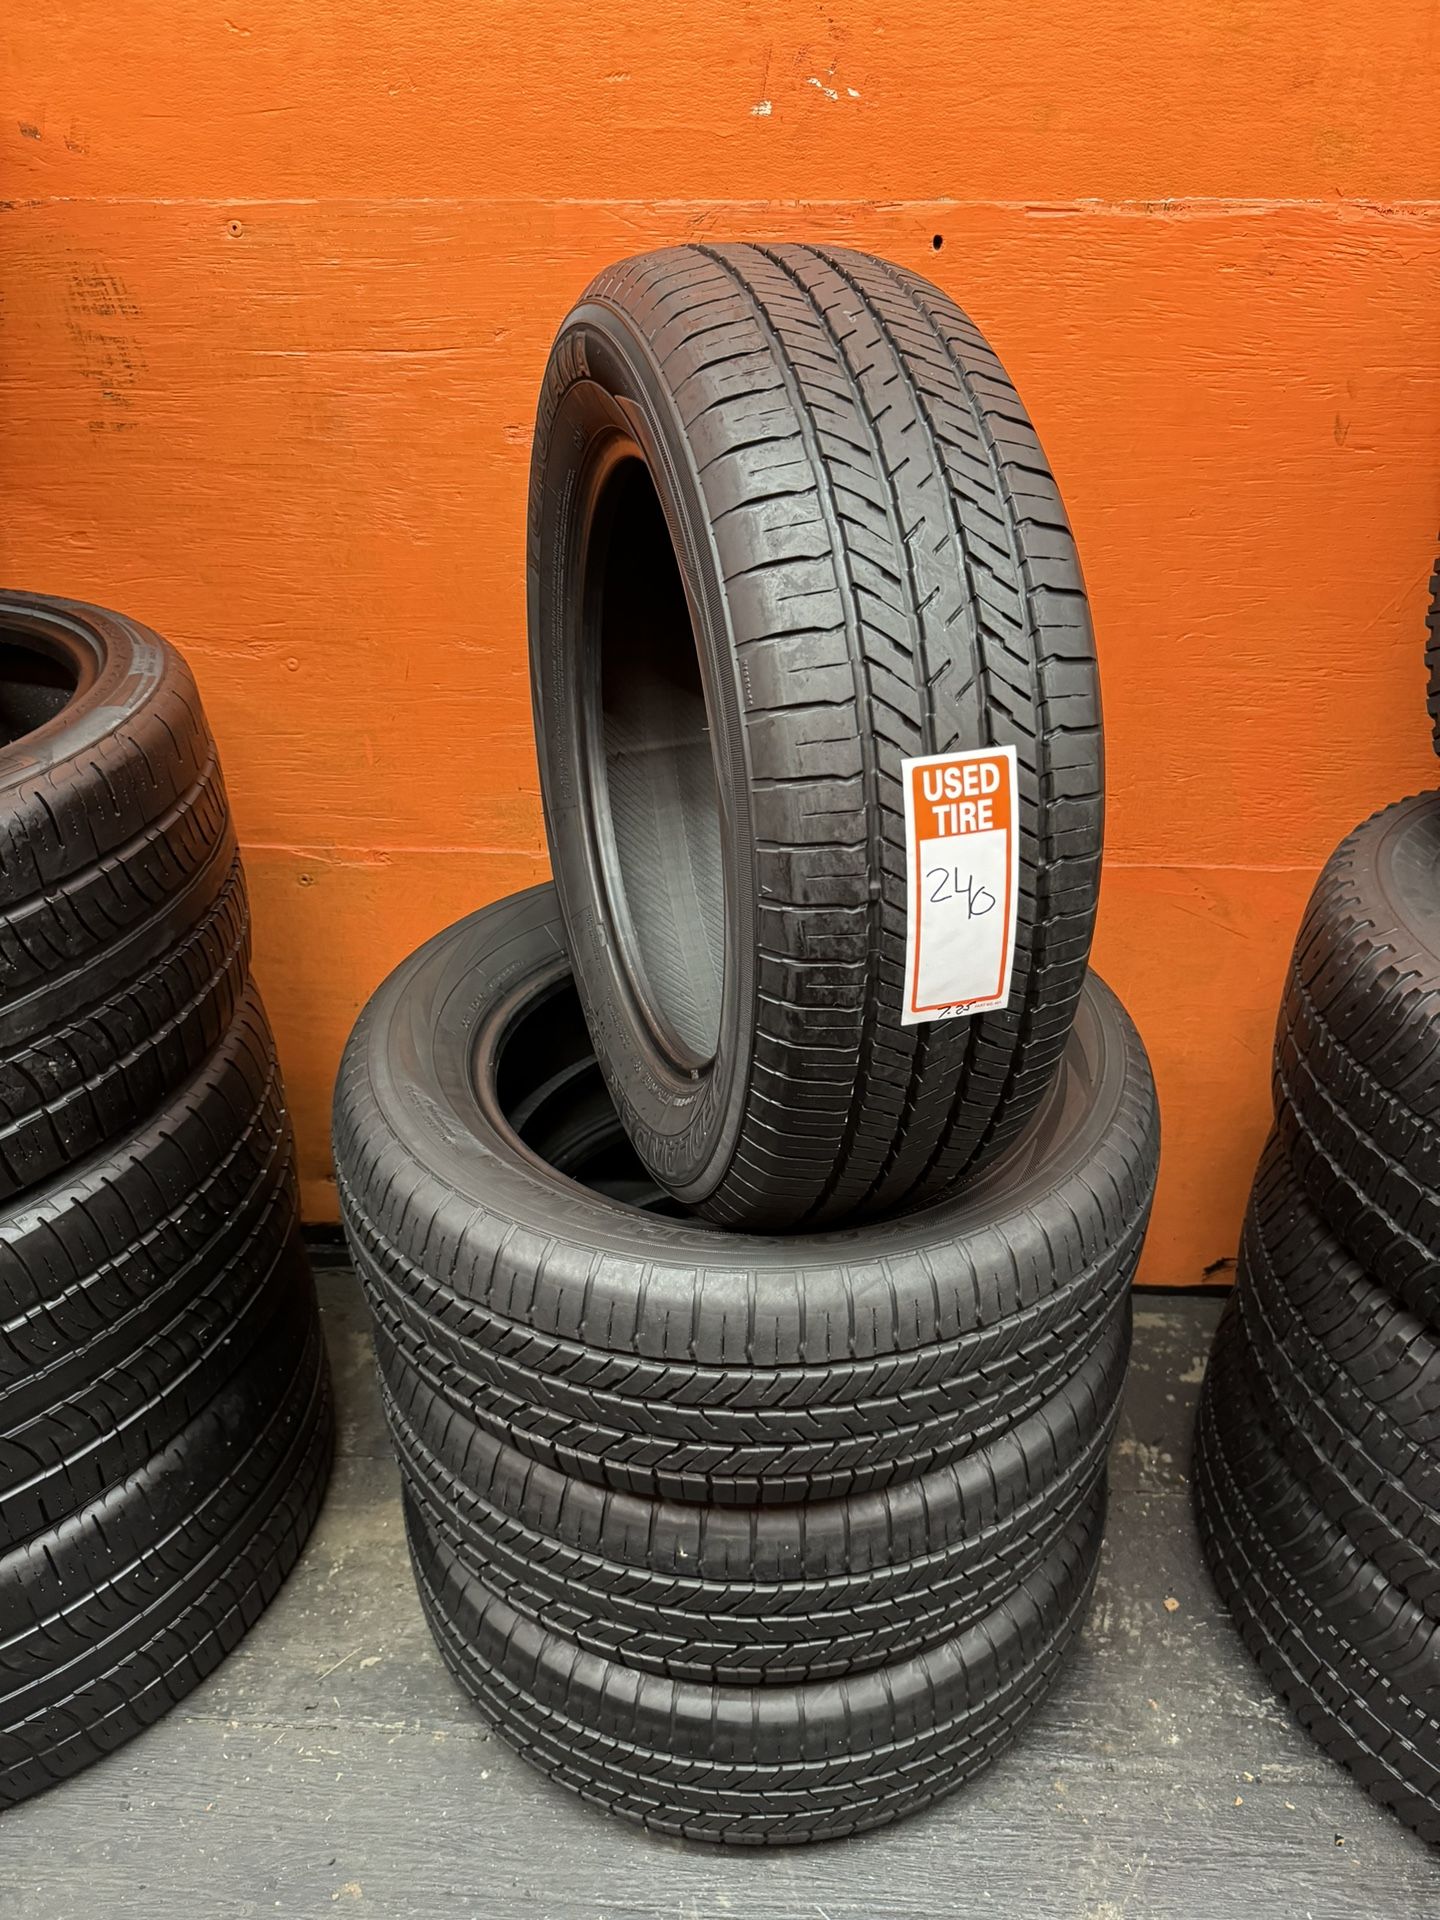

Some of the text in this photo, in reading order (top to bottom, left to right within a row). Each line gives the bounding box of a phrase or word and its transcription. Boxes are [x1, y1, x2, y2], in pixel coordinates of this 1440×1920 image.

[922, 761, 1001, 802] USED
[932, 799, 994, 837] TIRE
[926, 866, 996, 920] 240
